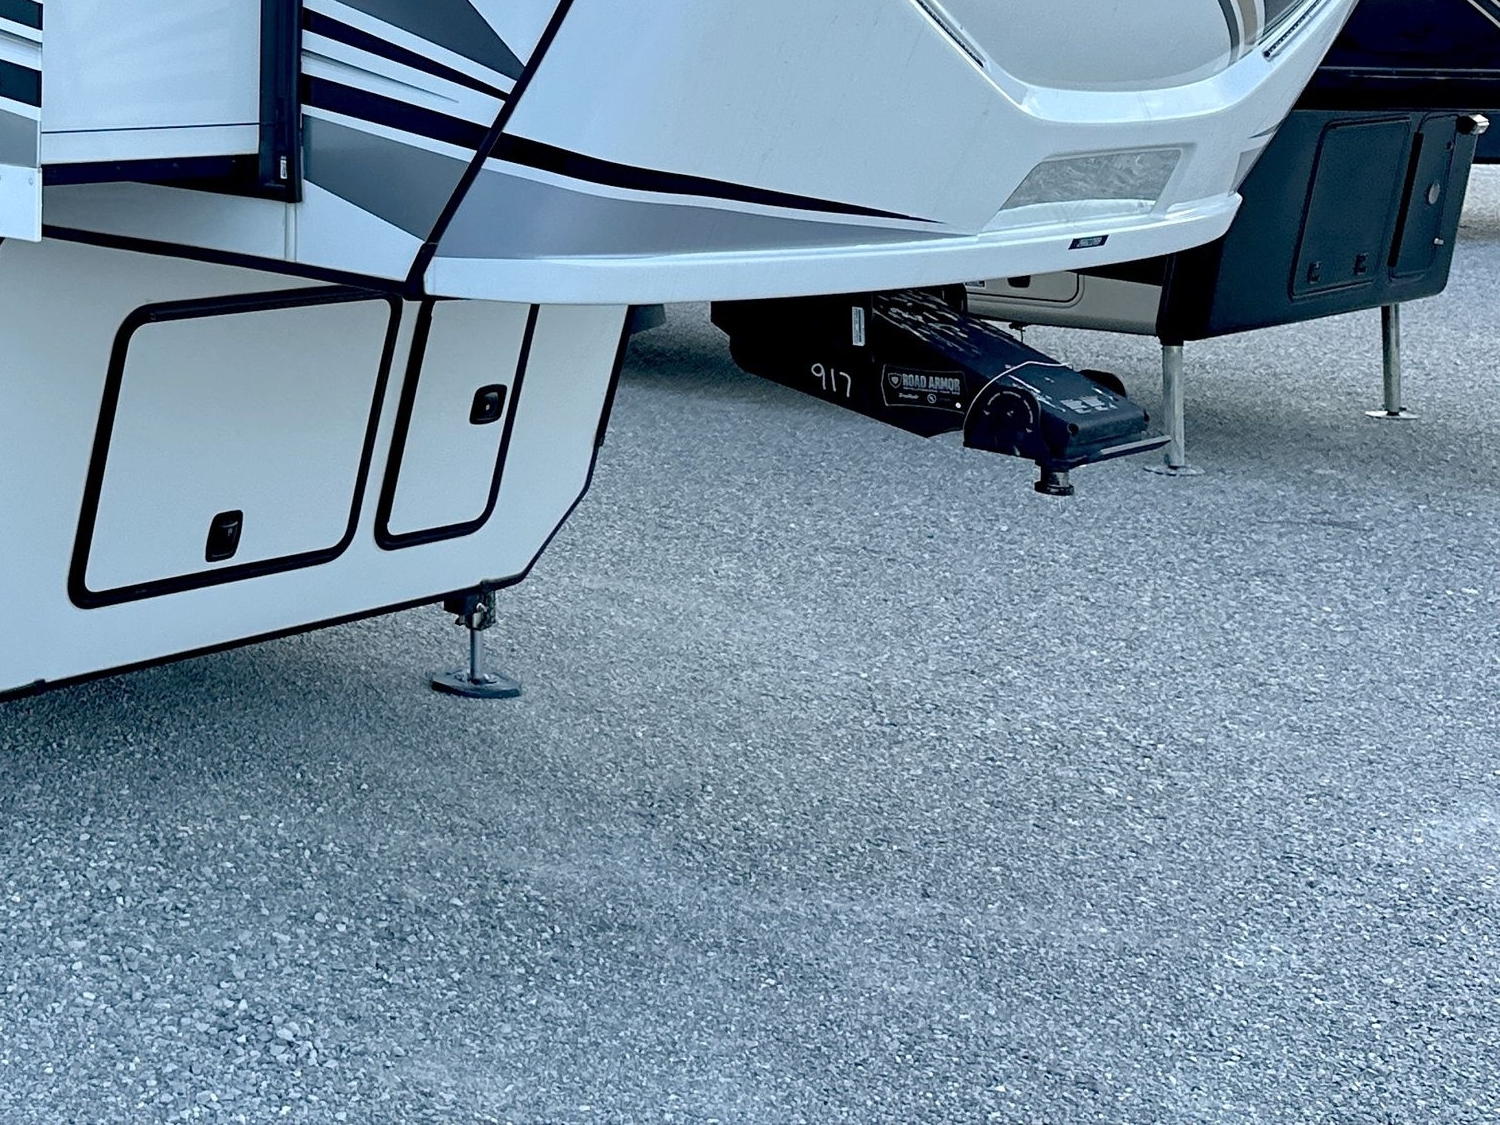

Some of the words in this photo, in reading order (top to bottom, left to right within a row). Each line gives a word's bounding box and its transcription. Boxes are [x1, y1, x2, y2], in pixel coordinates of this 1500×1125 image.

[811, 363, 851, 398] 917
[902, 373, 927, 388] ROAD
[928, 376, 960, 392] ARMOR
